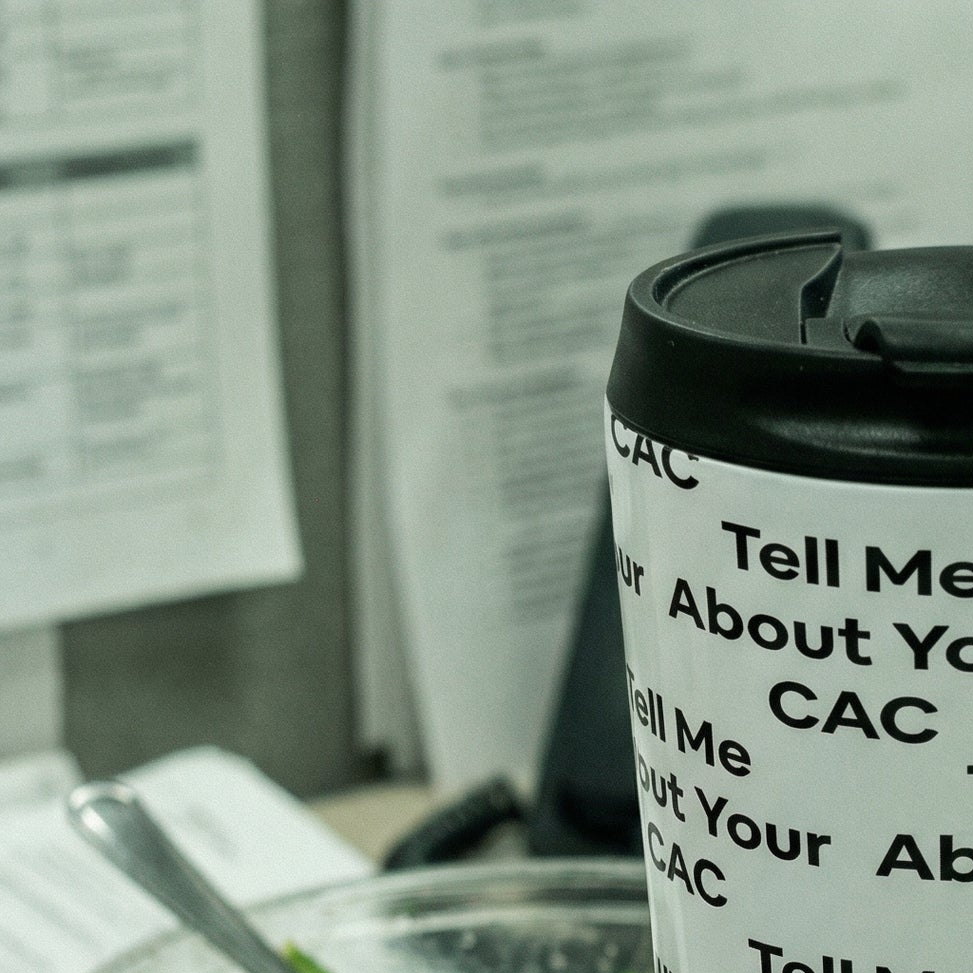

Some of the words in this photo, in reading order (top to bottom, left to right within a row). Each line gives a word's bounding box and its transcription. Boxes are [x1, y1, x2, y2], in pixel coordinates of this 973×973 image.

[610, 414, 700, 490] CAC
[720, 519, 841, 588] Tell
[668, 577, 873, 667] About
[674, 706, 752, 778] Me
[768, 680, 939, 745] CAC
[647, 821, 728, 908] CAC
[693, 785, 832, 868] Your
